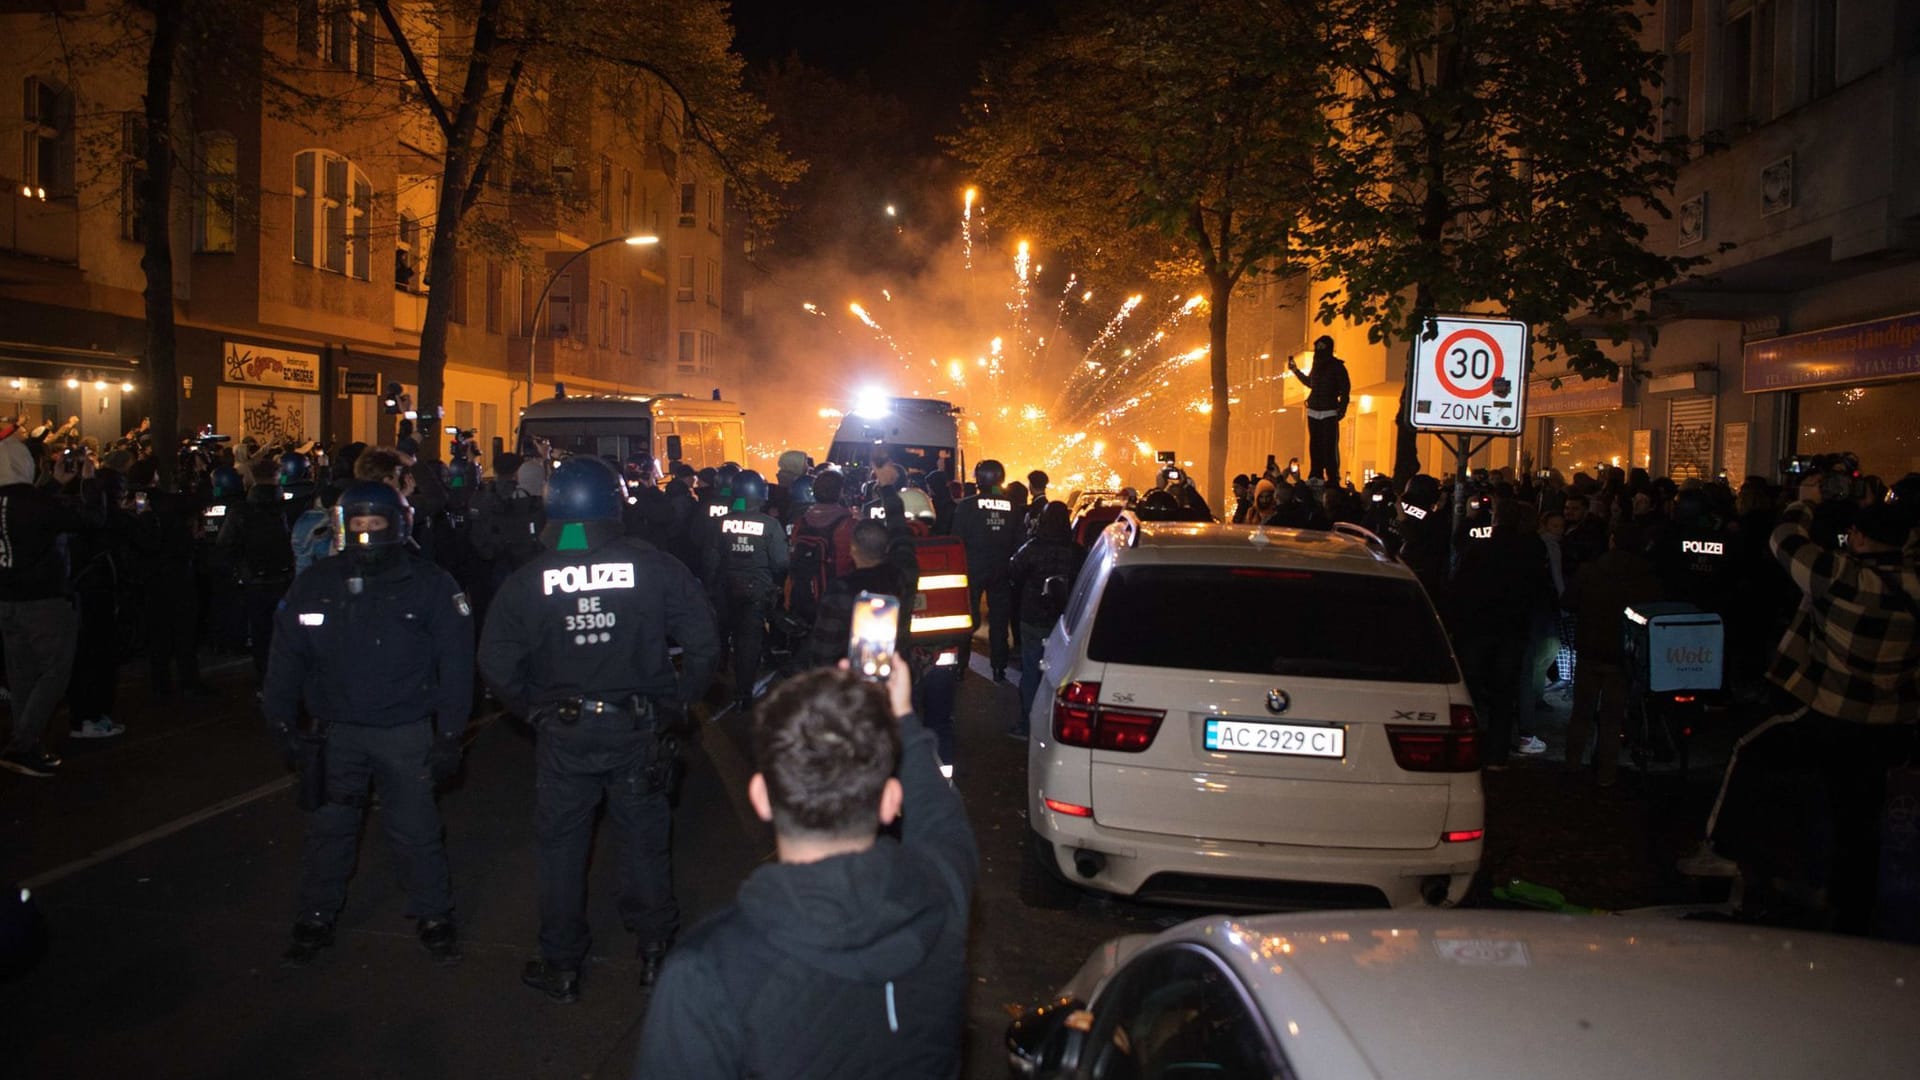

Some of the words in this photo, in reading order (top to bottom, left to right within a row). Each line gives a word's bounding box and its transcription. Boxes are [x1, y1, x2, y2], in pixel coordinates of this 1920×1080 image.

[1450, 348, 1489, 380] 30
[1440, 402, 1493, 422] ZONE
[977, 498, 1012, 512] POLIZEI
[722, 519, 765, 536] POLIZEI
[1682, 540, 1724, 555] POLIZEI
[543, 562, 635, 596] POLIZEI
[578, 596, 602, 614] BE
[565, 611, 617, 632] 35300
[1666, 646, 1712, 664] Wolt
[1391, 709, 1438, 722] X5
[1221, 727, 1251, 747] AC
[1256, 728, 1305, 751] 2929
[1311, 732, 1336, 752] CI
